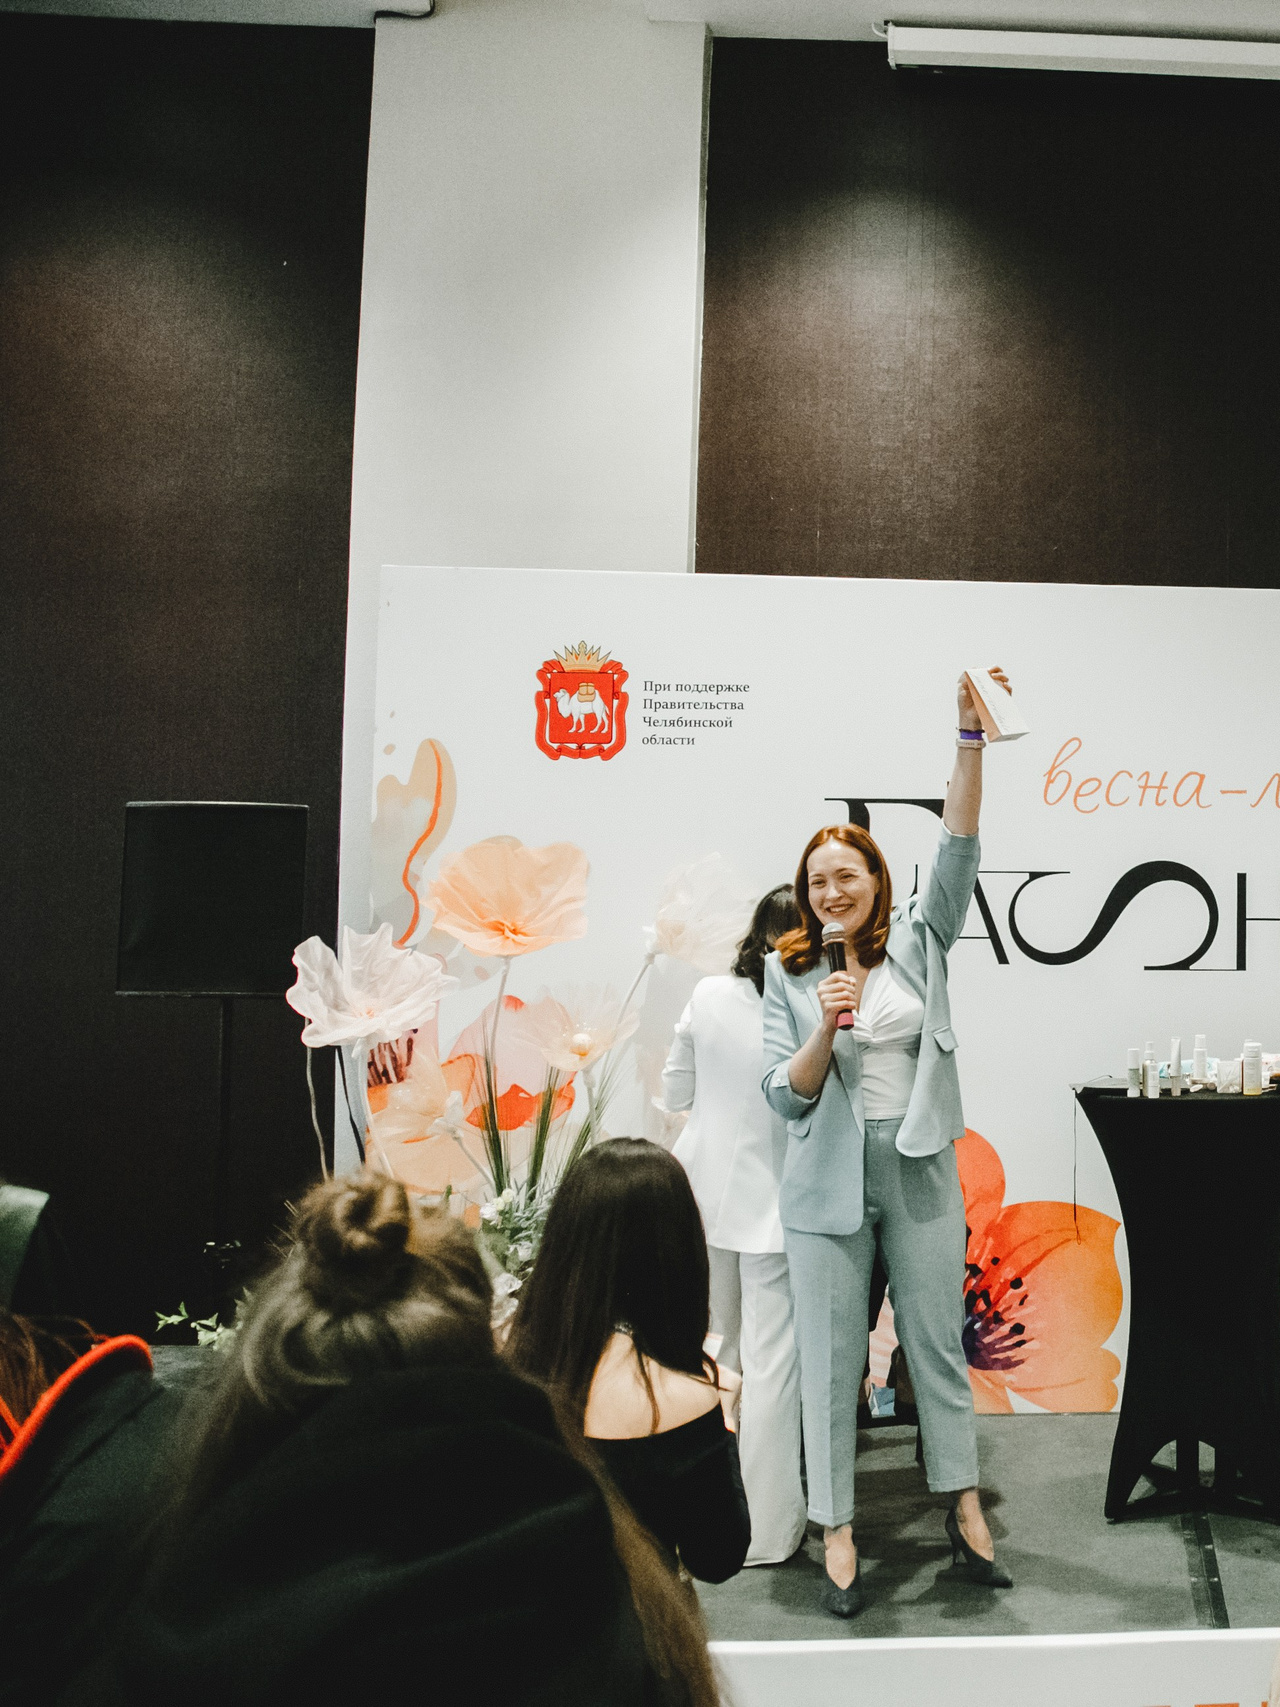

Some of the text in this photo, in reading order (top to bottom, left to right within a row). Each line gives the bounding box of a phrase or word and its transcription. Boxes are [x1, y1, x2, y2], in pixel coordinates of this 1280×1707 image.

[643, 680, 750, 694] При поддержке
[643, 698, 744, 711] Правительства
[643, 715, 733, 729] Челябинской
[642, 734, 695, 746] области
